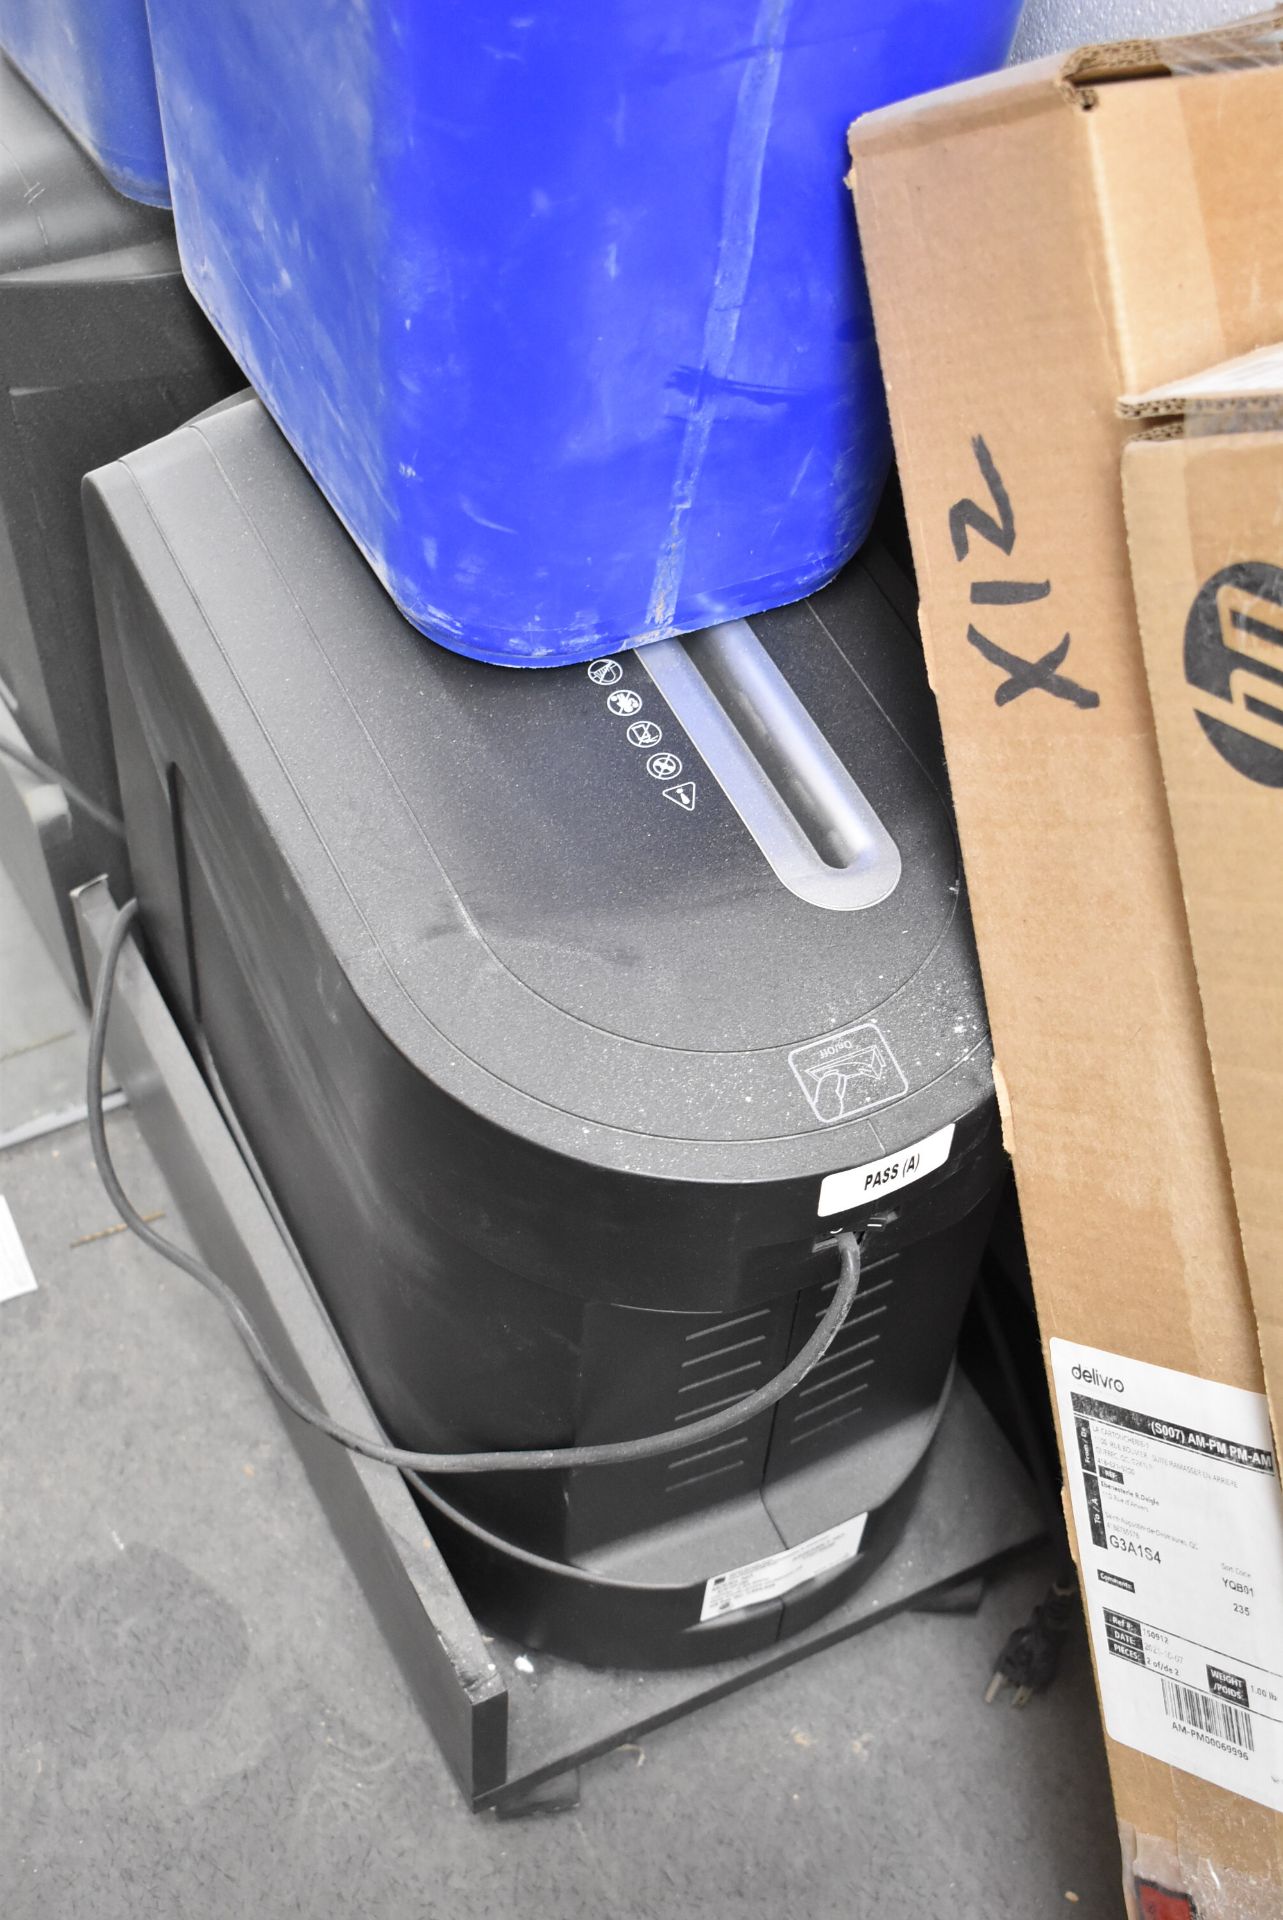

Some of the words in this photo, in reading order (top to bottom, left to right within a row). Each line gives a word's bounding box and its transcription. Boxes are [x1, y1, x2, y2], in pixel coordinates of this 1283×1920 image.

[819, 1040, 852, 1059] On/Off
[864, 1162, 899, 1191] PASS
[902, 1152, 921, 1177] (A)
[1071, 1363, 1125, 1393] delivro
[1150, 1420, 1185, 1443] (S007)
[1187, 1431, 1227, 1454] AM-PM
[1229, 1444, 1271, 1468] PM-AM
[1093, 1513, 1101, 1525] To
[1108, 1533, 1161, 1564] G3A1S4
[1222, 1577, 1253, 1597] YQB01
[1232, 1602, 1250, 1617] 235
[1112, 1615, 1125, 1627] Ref
[1211, 1669, 1242, 1689] WEIGHT
[1172, 1720, 1248, 1761] AM-PM00069996
